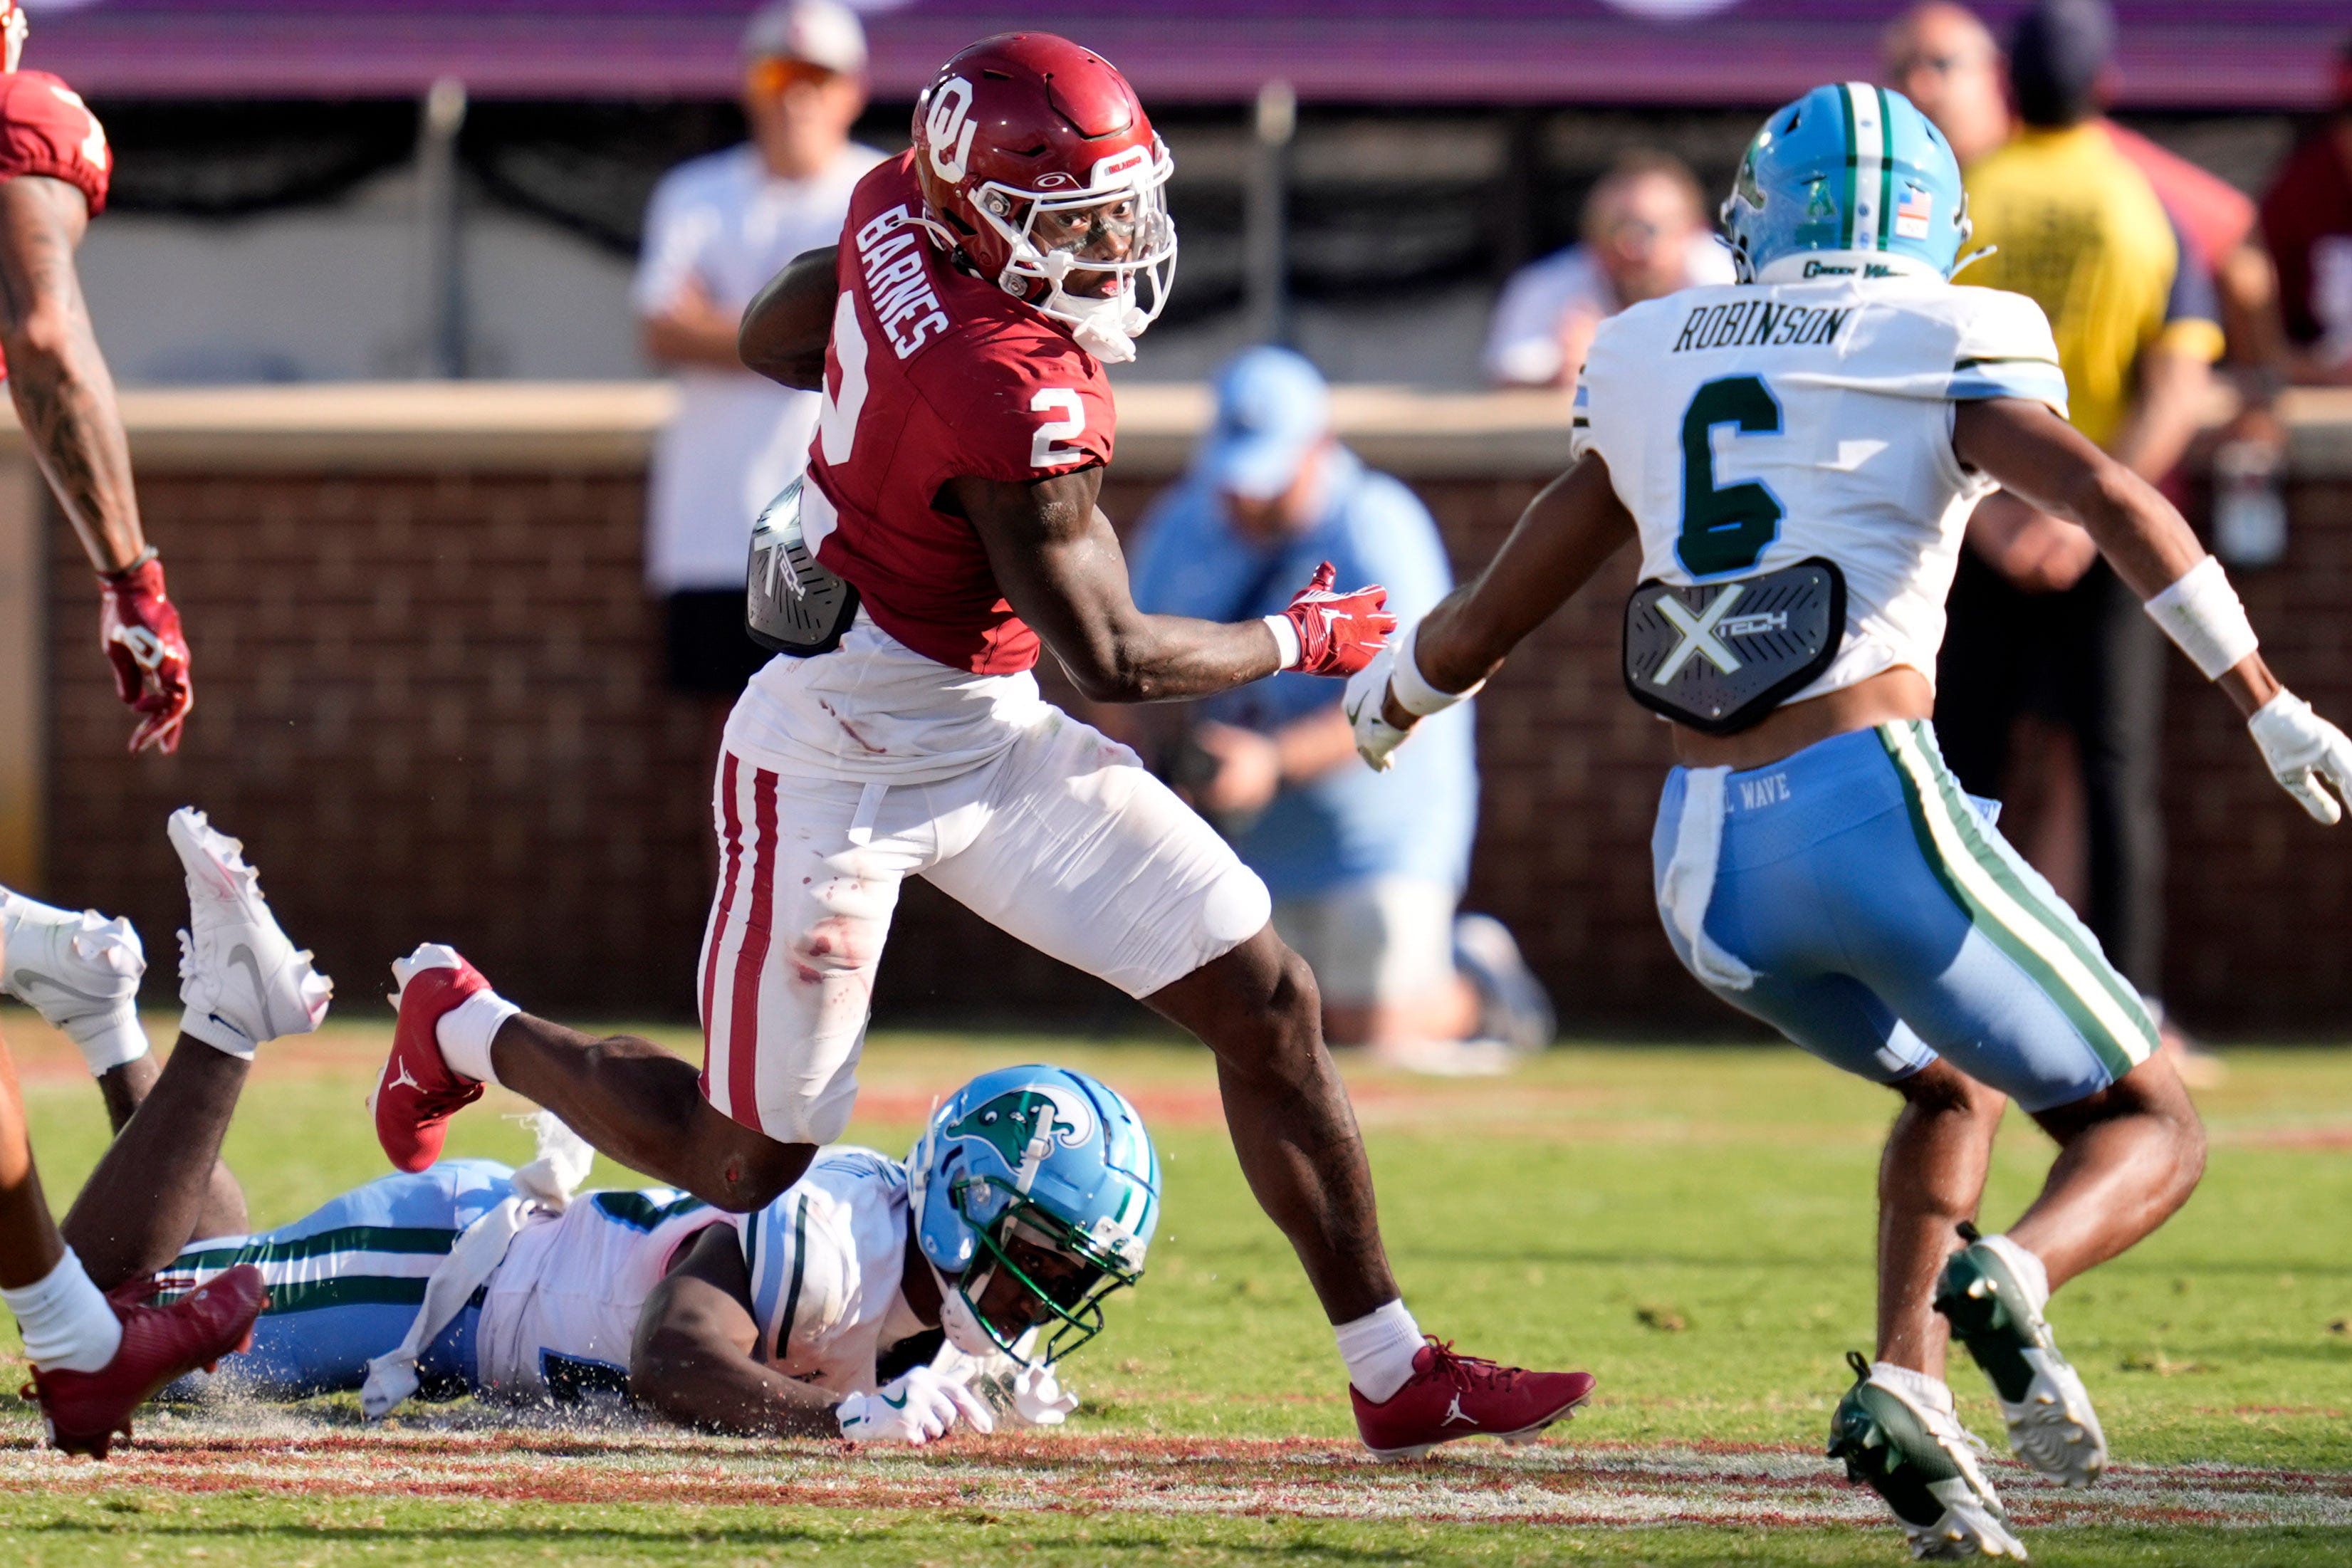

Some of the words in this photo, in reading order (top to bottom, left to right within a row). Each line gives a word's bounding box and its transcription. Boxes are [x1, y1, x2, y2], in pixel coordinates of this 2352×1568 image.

[925, 76, 978, 184] OU
[856, 204, 949, 360] BARNES
[1673, 300, 1852, 352] ROBINSON
[1030, 388, 1085, 467] 2
[1673, 373, 1787, 584] 6
[1740, 773, 1791, 810] WAVE
